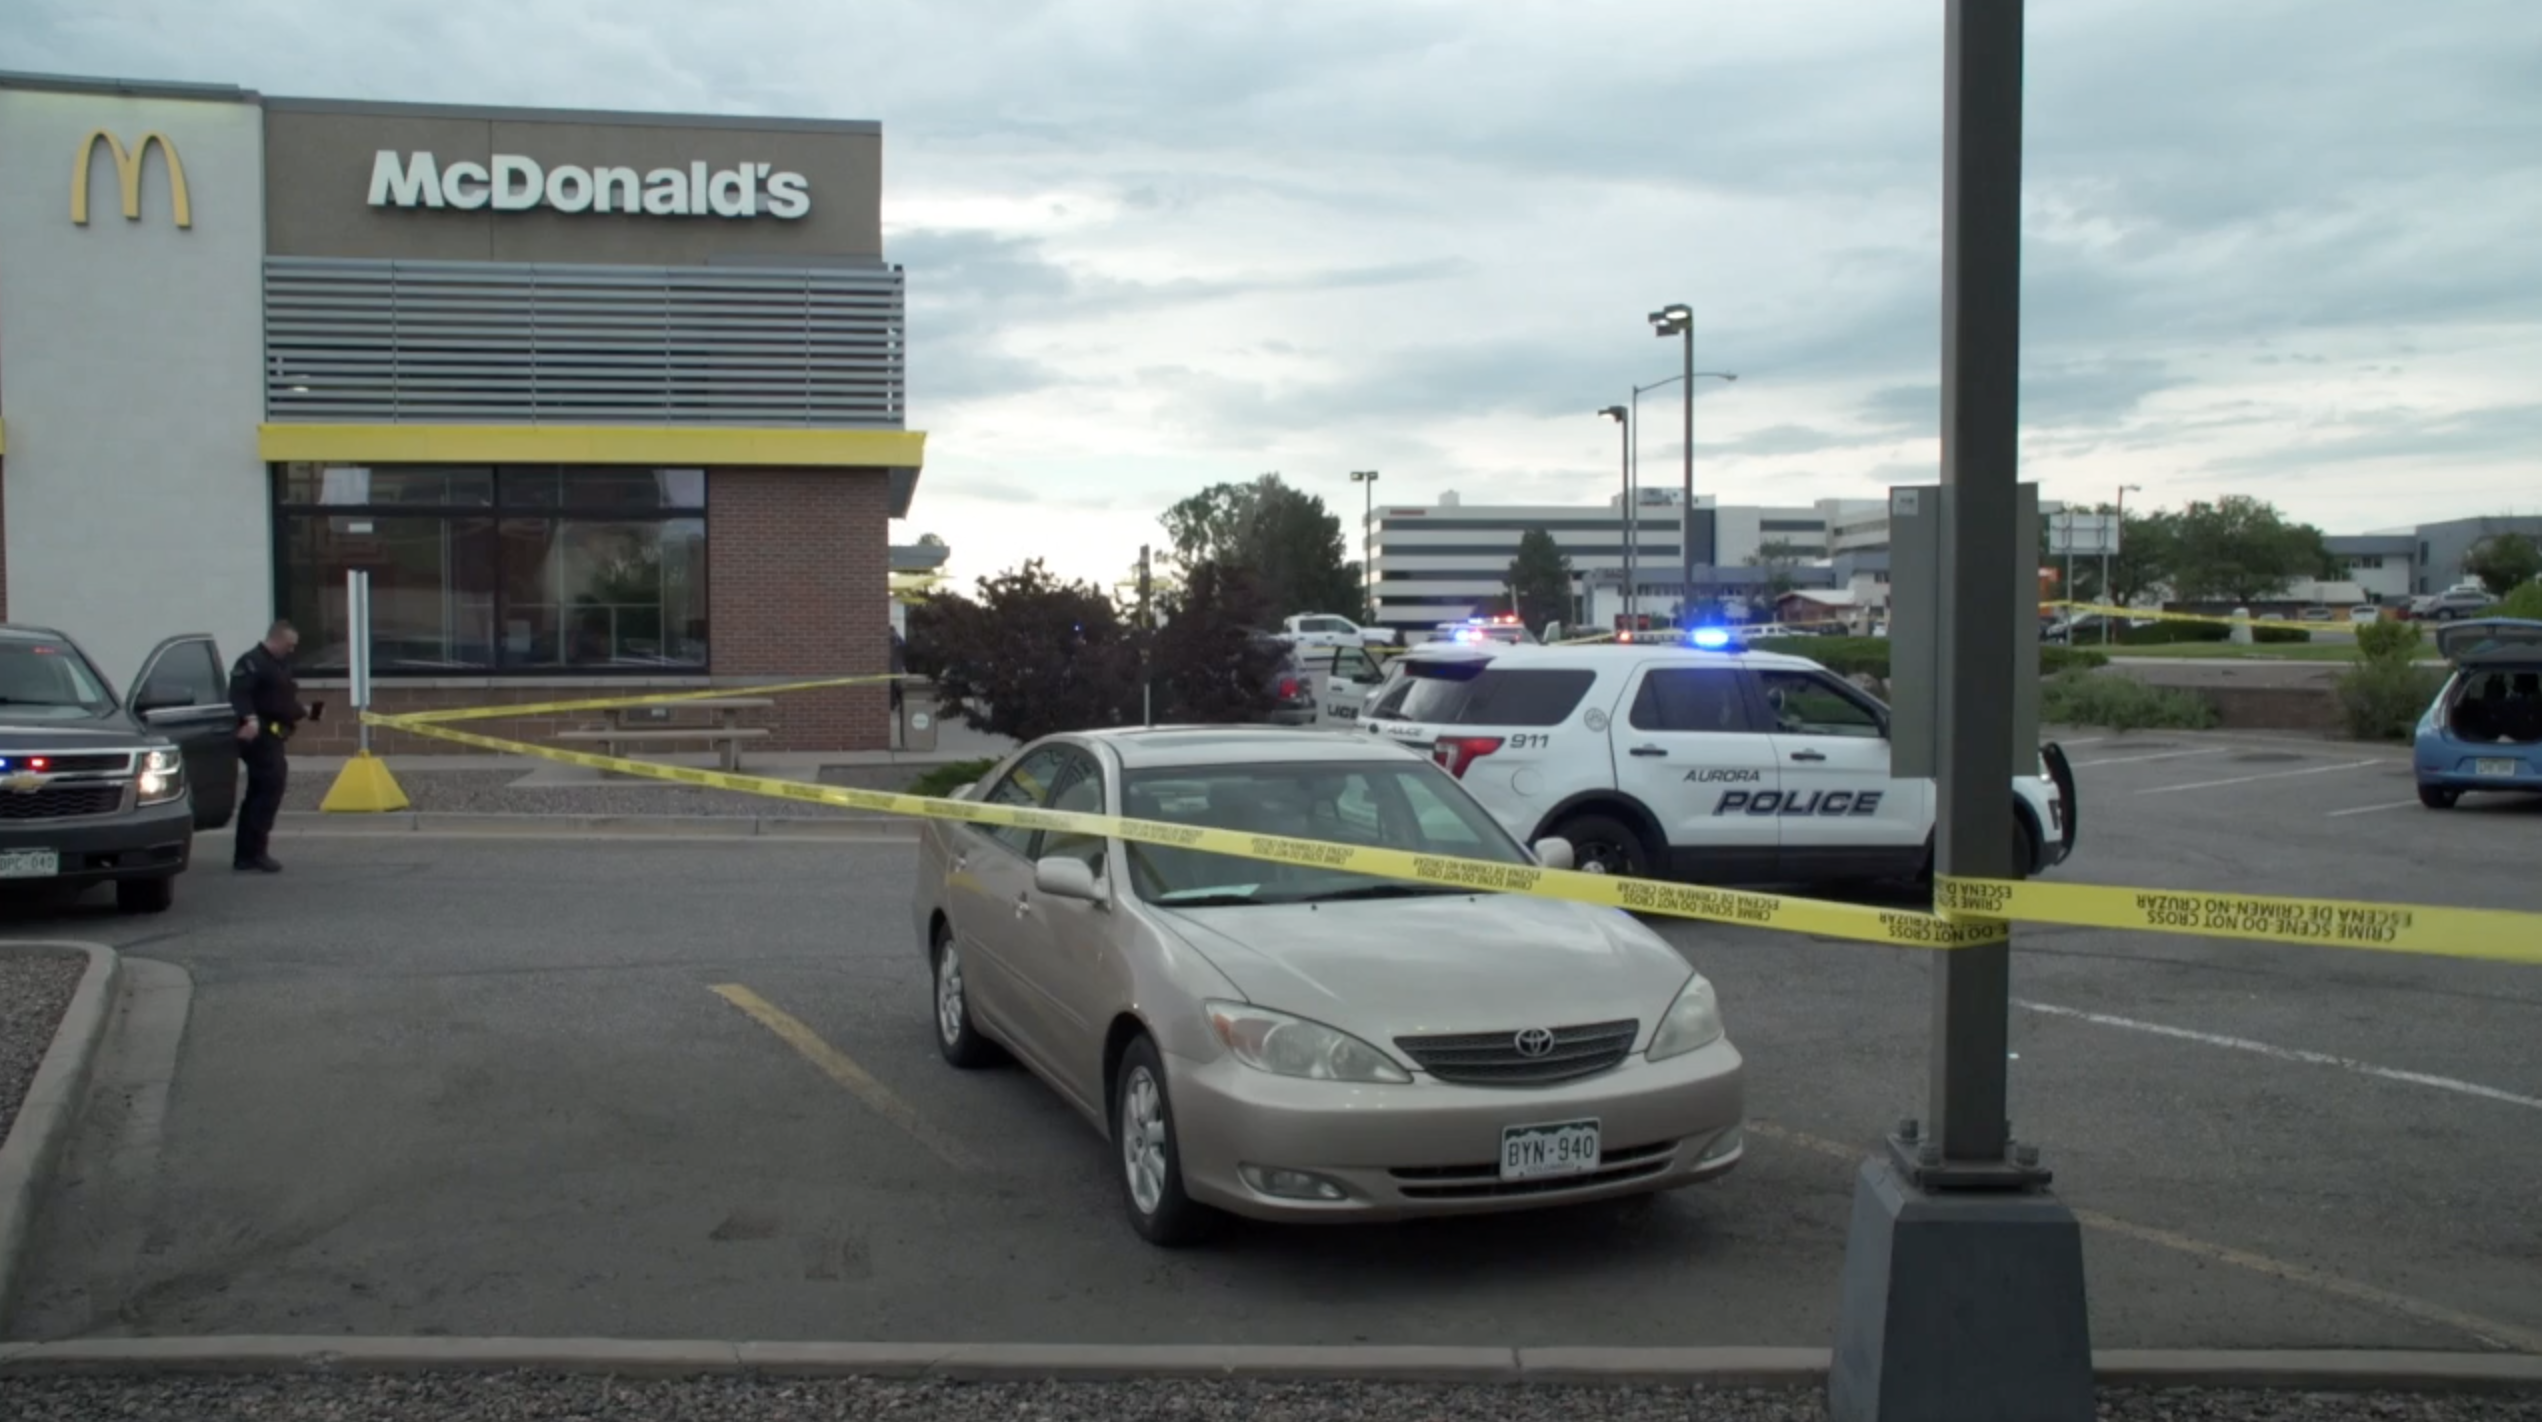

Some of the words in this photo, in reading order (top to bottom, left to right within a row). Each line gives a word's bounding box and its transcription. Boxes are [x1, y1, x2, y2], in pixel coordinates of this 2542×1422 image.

[367, 149, 811, 219] McDonald's
[1509, 734, 1550, 749] 911
[1683, 769, 1761, 782] AURORA
[1711, 789, 1885, 817] POLICE
[1960, 883, 2013, 899] ESCENA
[1961, 899, 2003, 912] CRIME
[2135, 893, 2201, 911] CRUZAR
[2146, 909, 2199, 928] CROSS
[2308, 904, 2333, 921] DE
[2338, 907, 2413, 929] ESCENA
[2202, 914, 2238, 930] NOT
[1888, 925, 1931, 941] CROSS
[2337, 923, 2397, 943] CRIME
[1508, 1135, 1595, 1168] BYN-940
